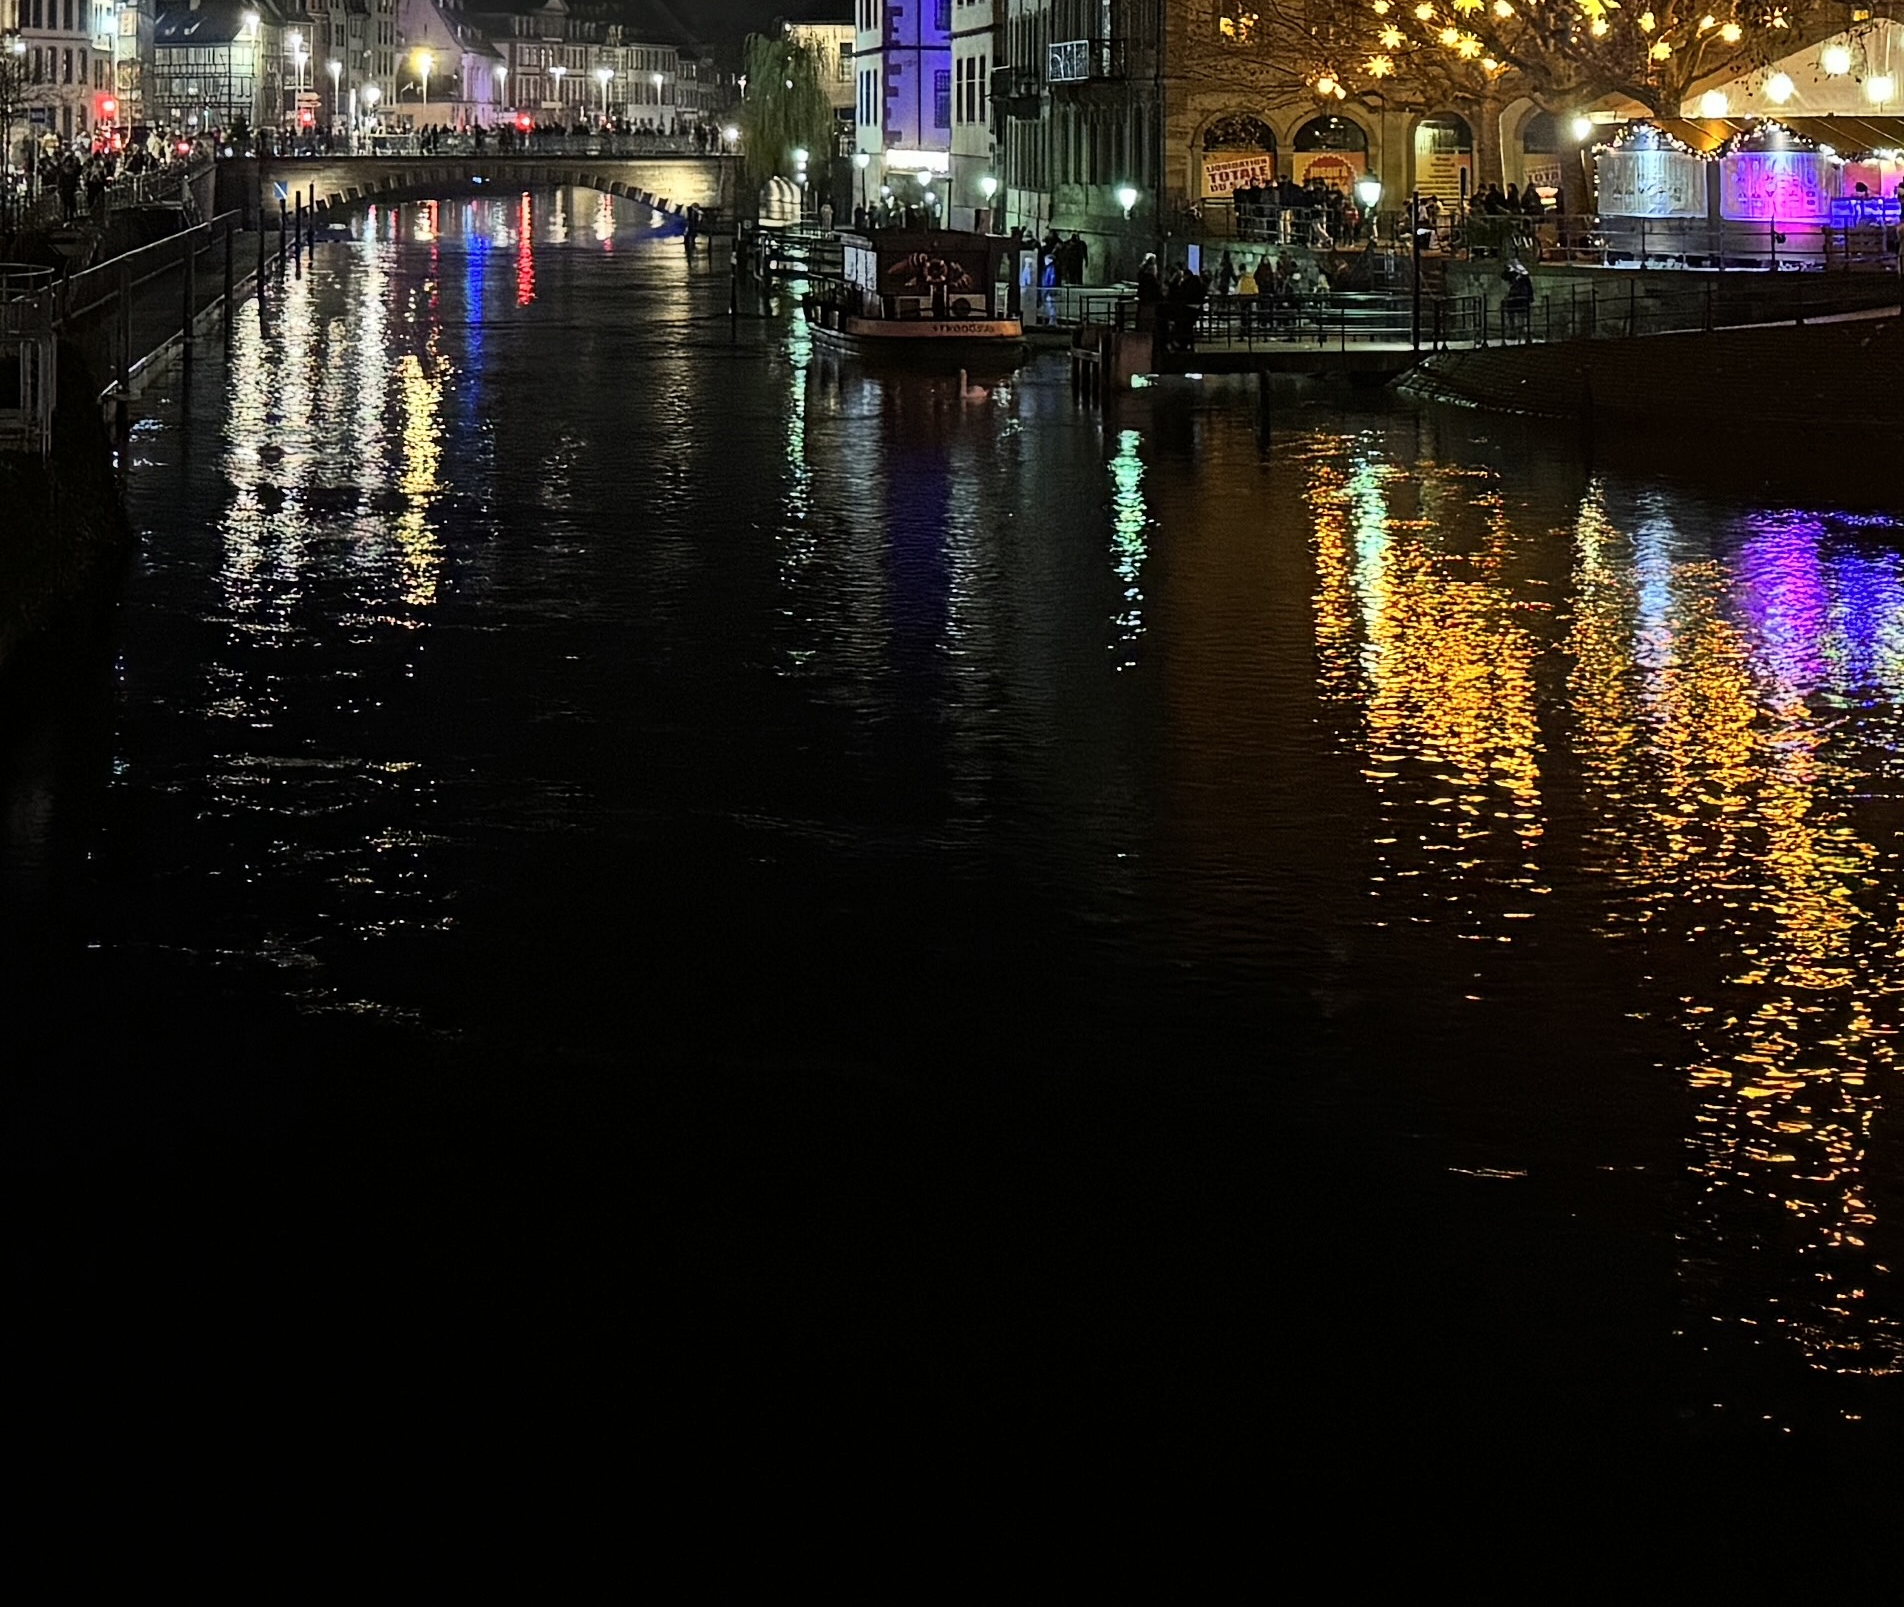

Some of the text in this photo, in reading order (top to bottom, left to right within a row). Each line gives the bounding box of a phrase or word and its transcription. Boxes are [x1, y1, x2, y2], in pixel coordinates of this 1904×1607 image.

[1206, 157, 1268, 173] LIQUIDATION
[1208, 164, 1269, 184] TOTALE
[1210, 183, 1227, 192] DU
